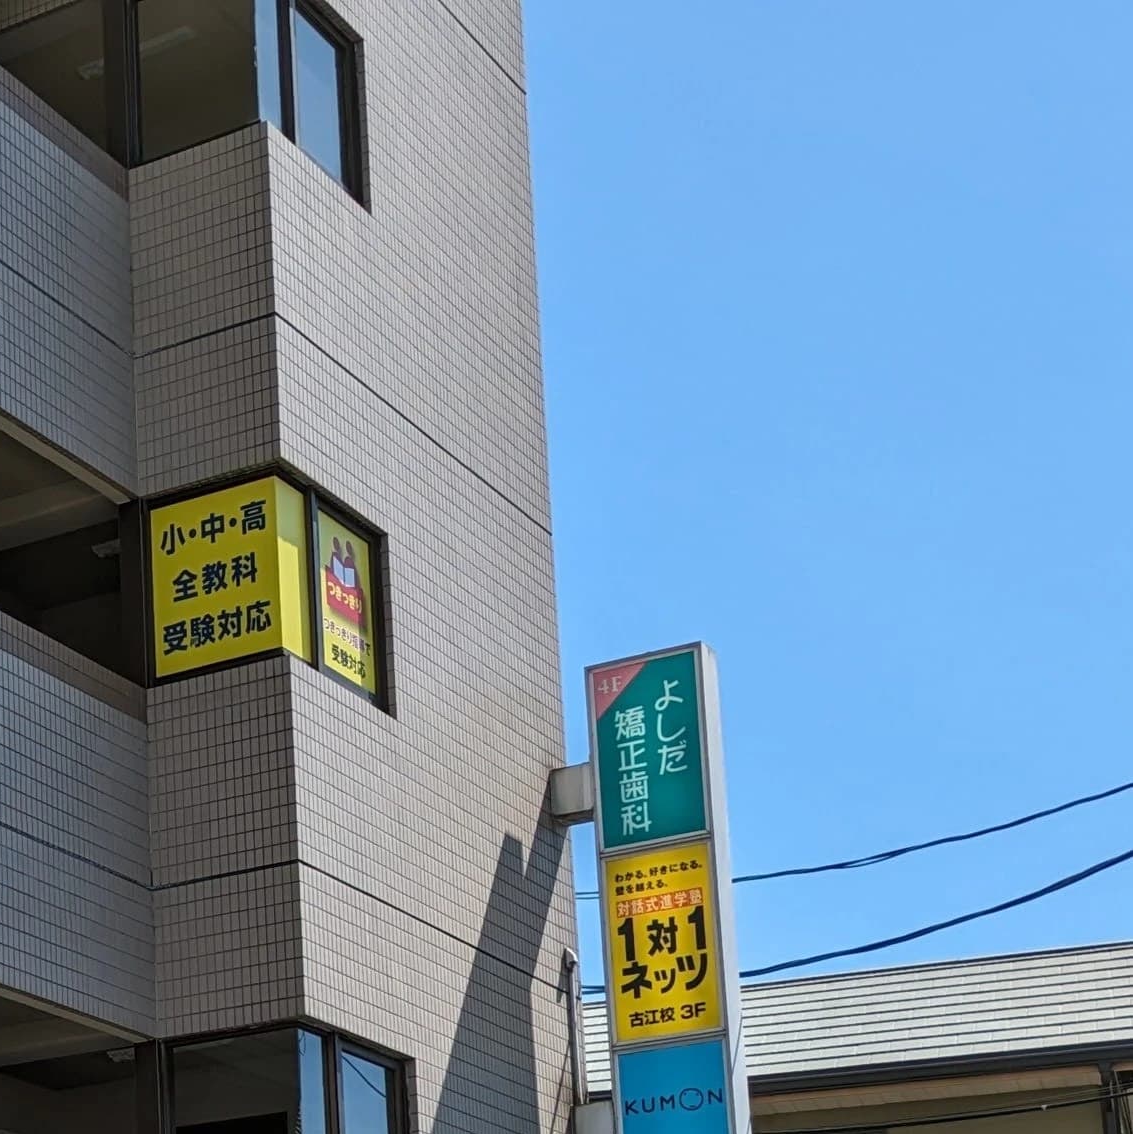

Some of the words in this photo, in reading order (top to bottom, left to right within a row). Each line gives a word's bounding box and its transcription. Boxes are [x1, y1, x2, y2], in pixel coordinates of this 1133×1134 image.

[172, 552, 258, 603] 全教科
[163, 600, 273, 656] 受験対応
[331, 643, 366, 679] 受験対応
[597, 675, 623, 695] 4F
[654, 679, 688, 776] よしだ
[614, 705, 653, 836] 矯正歯科
[617, 888, 703, 918] 対話式進学塾
[617, 905, 707, 962] 1対1
[621, 952, 708, 1000] ネッツ
[629, 1006, 675, 1028] 古江校
[680, 1002, 707, 1020] 3F
[624, 1087, 724, 1116] KUMON
